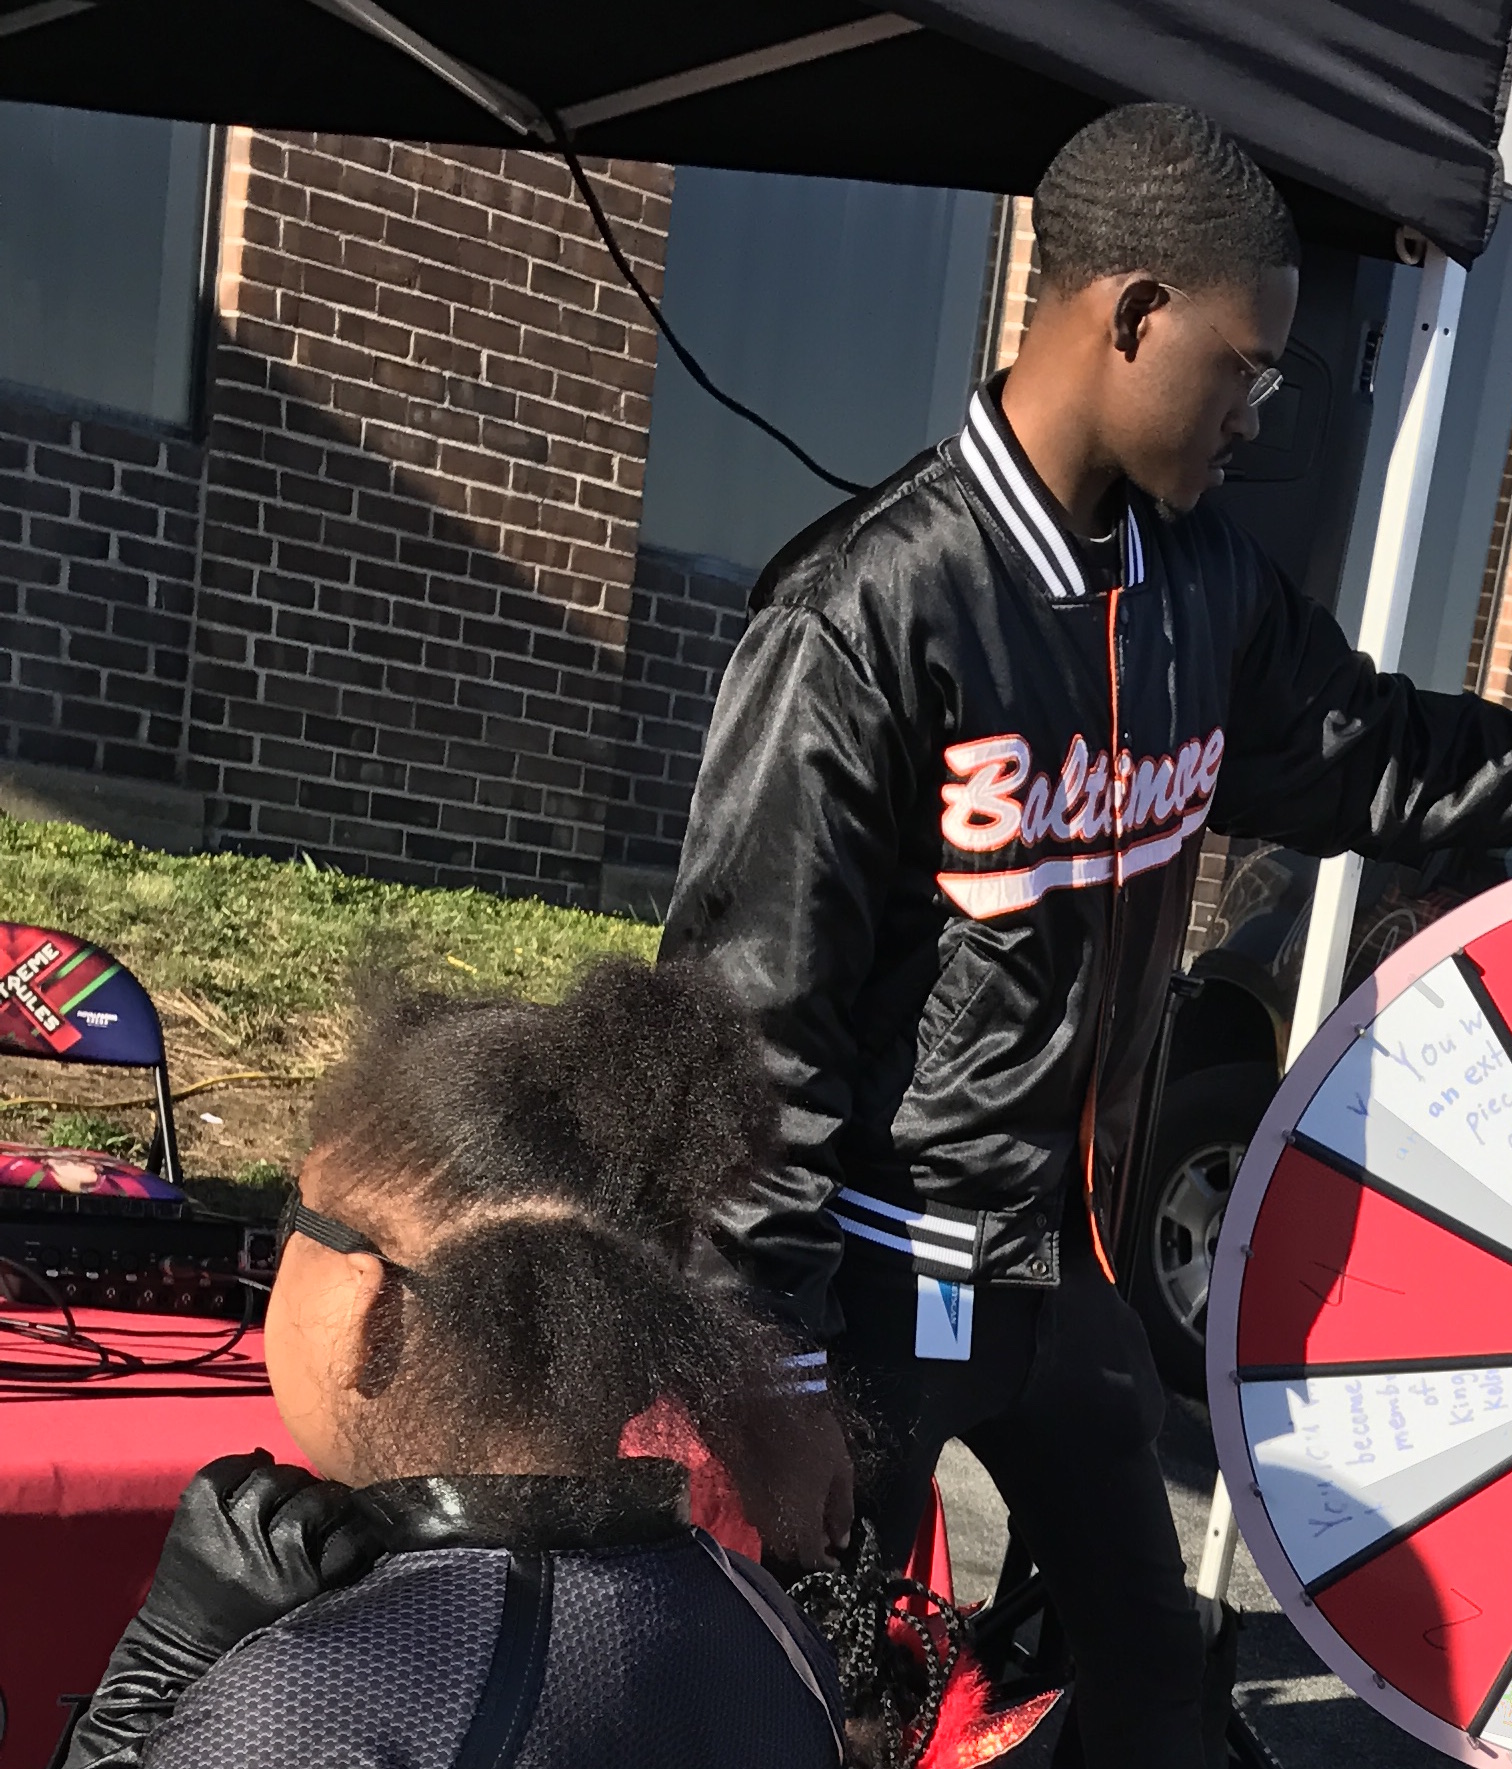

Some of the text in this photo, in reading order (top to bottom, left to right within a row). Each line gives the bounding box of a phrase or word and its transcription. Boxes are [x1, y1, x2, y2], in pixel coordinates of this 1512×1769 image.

[941, 726, 1226, 852] Baltimore
[1390, 1034, 1457, 1083] You
[1428, 1039, 1504, 1118] an ext
[1344, 1379, 1376, 1466] become
[1408, 1377, 1440, 1406] of
[1449, 1372, 1479, 1426] King
[1422, 1588, 1483, 1651] 2
